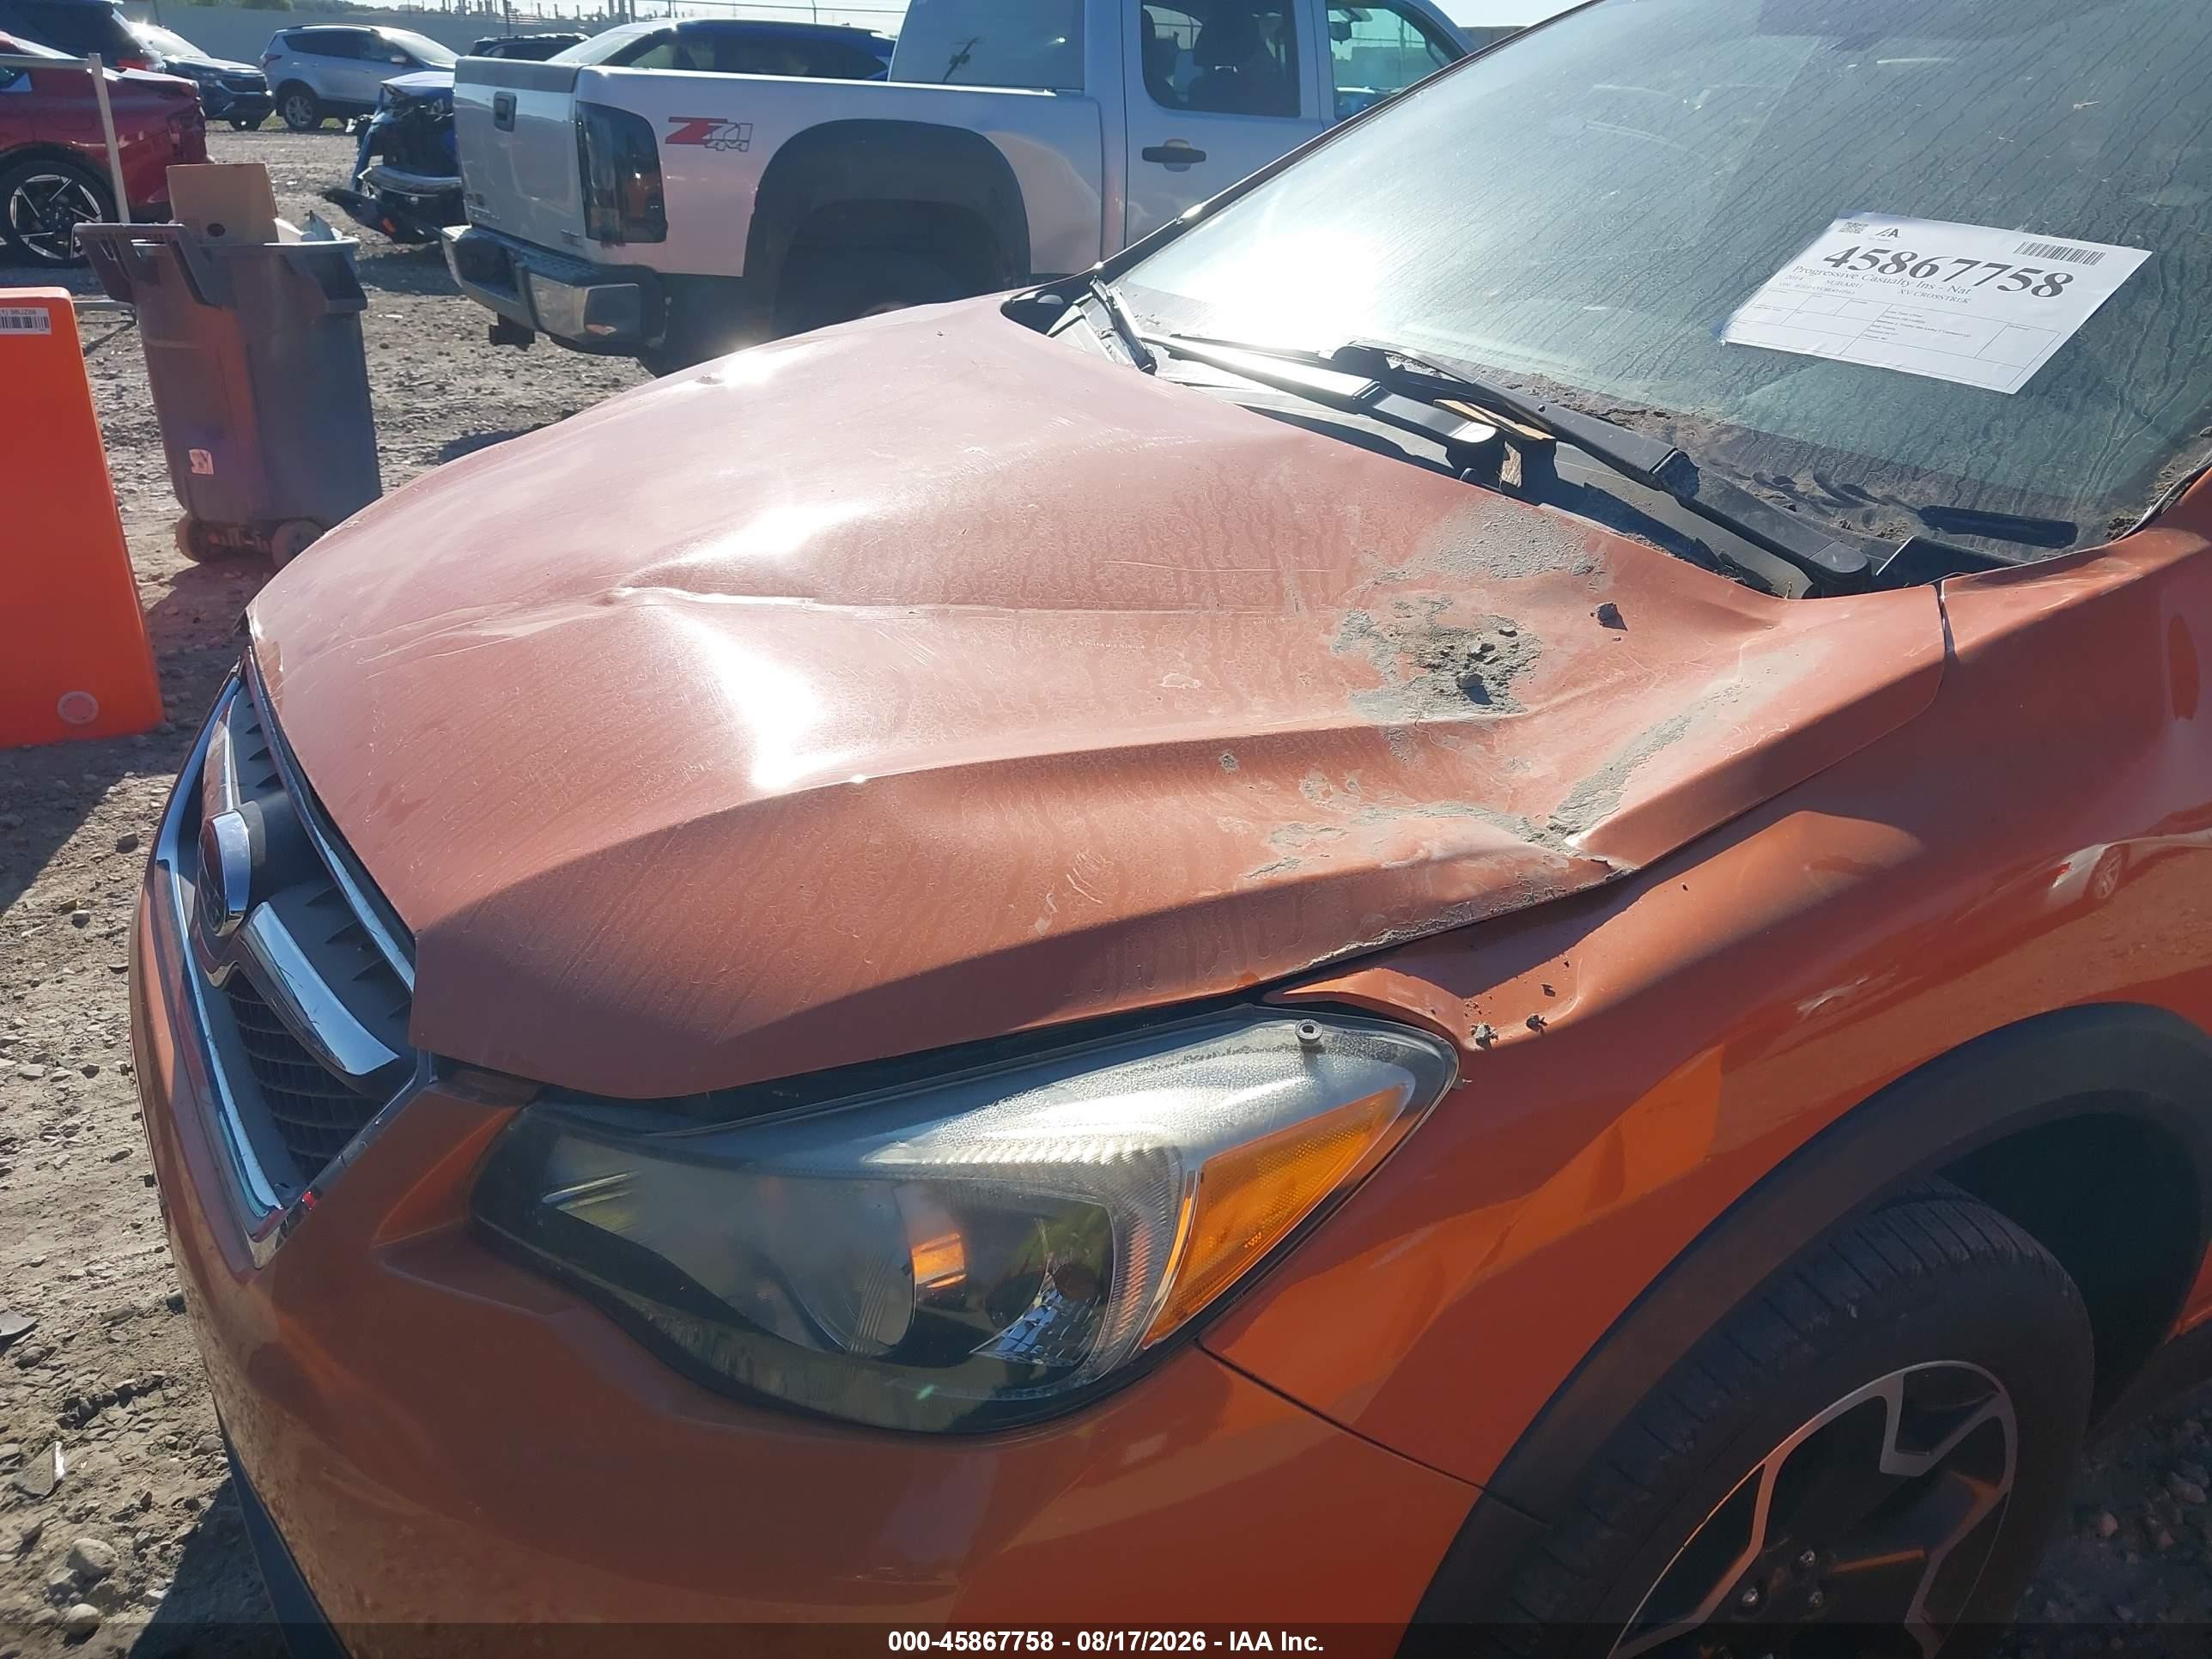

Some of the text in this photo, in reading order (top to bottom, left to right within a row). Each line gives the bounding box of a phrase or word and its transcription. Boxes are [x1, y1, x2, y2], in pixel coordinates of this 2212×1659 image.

[665, 117, 753, 143] Z71
[1793, 265, 1859, 281] Progressive
[1862, 274, 1914, 288] Casualty
[1917, 281, 1936, 289] Ins
[1948, 284, 1972, 295] Nat
[1823, 246, 2075, 298] 45867758
[1826, 280, 1864, 289] SUBARU
[1912, 290, 1972, 303] CROSSTREK
